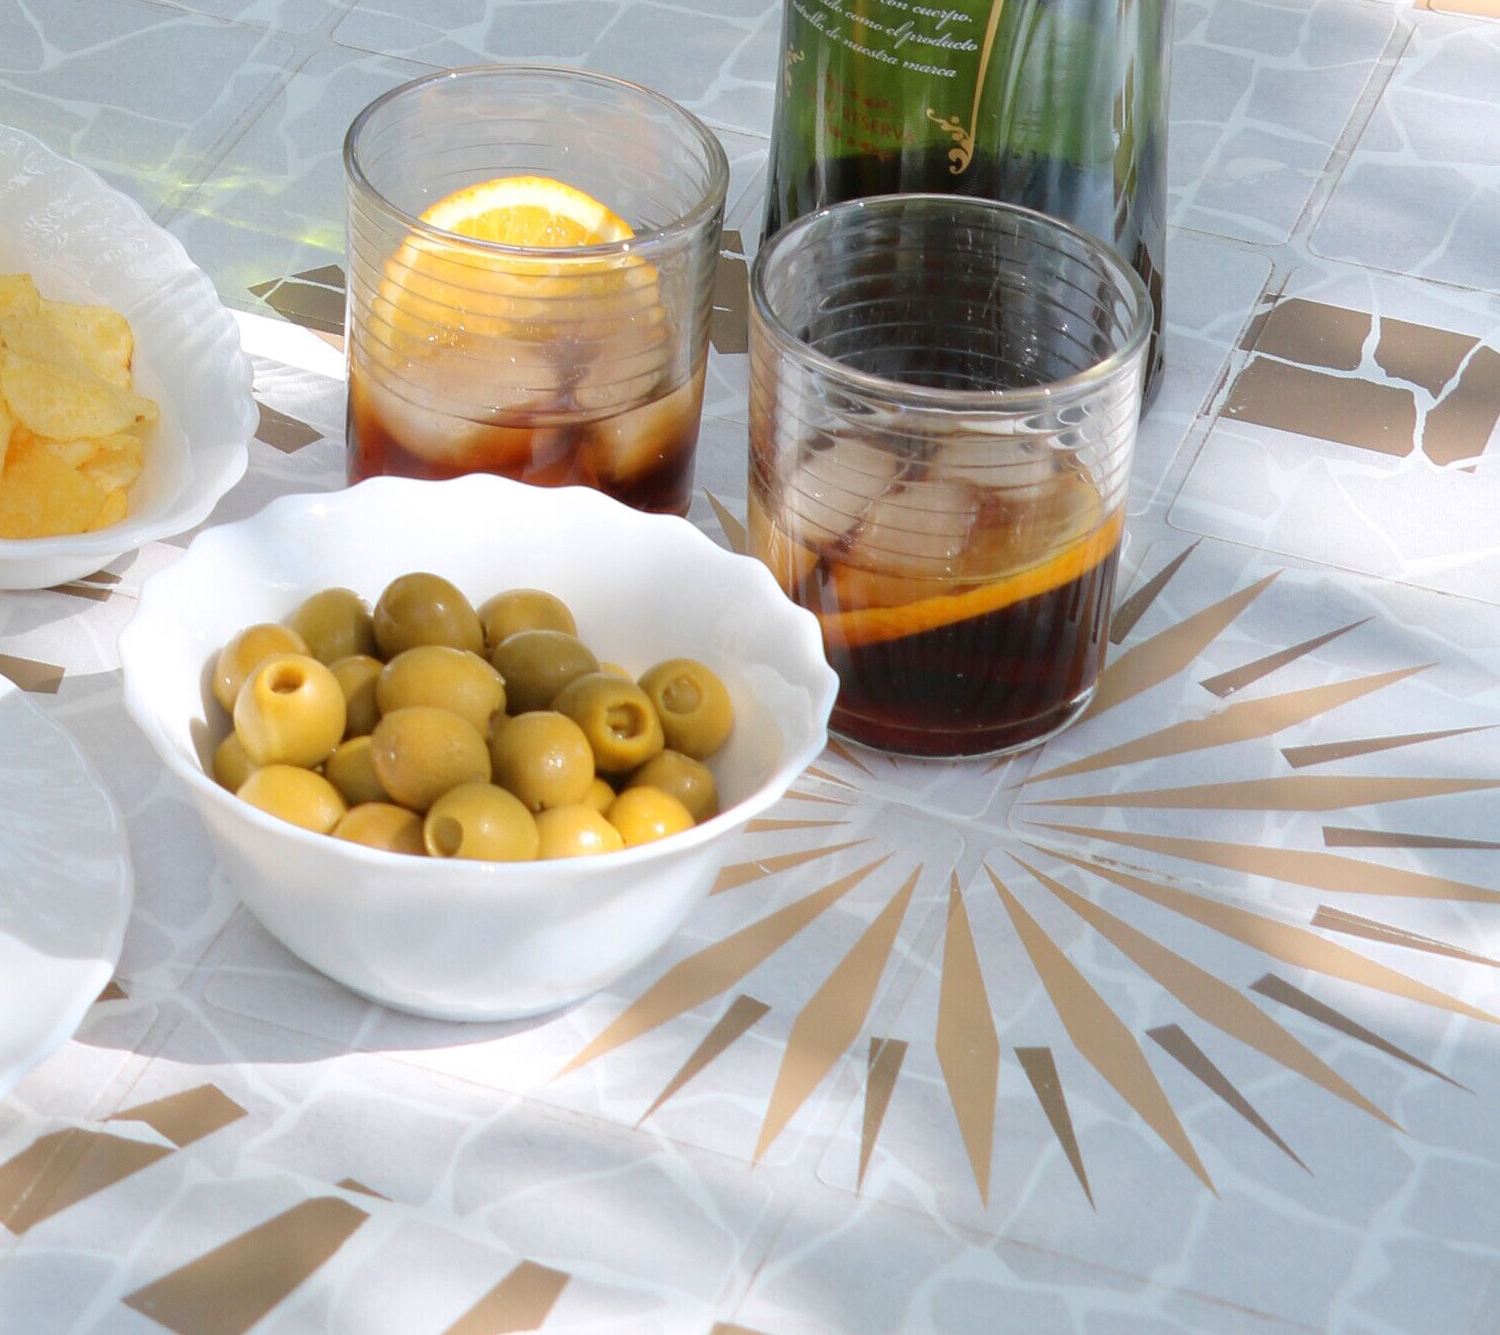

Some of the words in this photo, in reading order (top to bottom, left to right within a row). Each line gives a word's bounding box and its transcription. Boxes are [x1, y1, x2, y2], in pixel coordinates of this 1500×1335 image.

[844, 9, 884, 32] como
[885, 20, 916, 38] el
[911, 5, 973, 31] cuerpo.
[893, 29, 979, 52] producto
[825, 26, 842, 42] de
[843, 37, 899, 66] nuestra
[901, 59, 958, 79] marca
